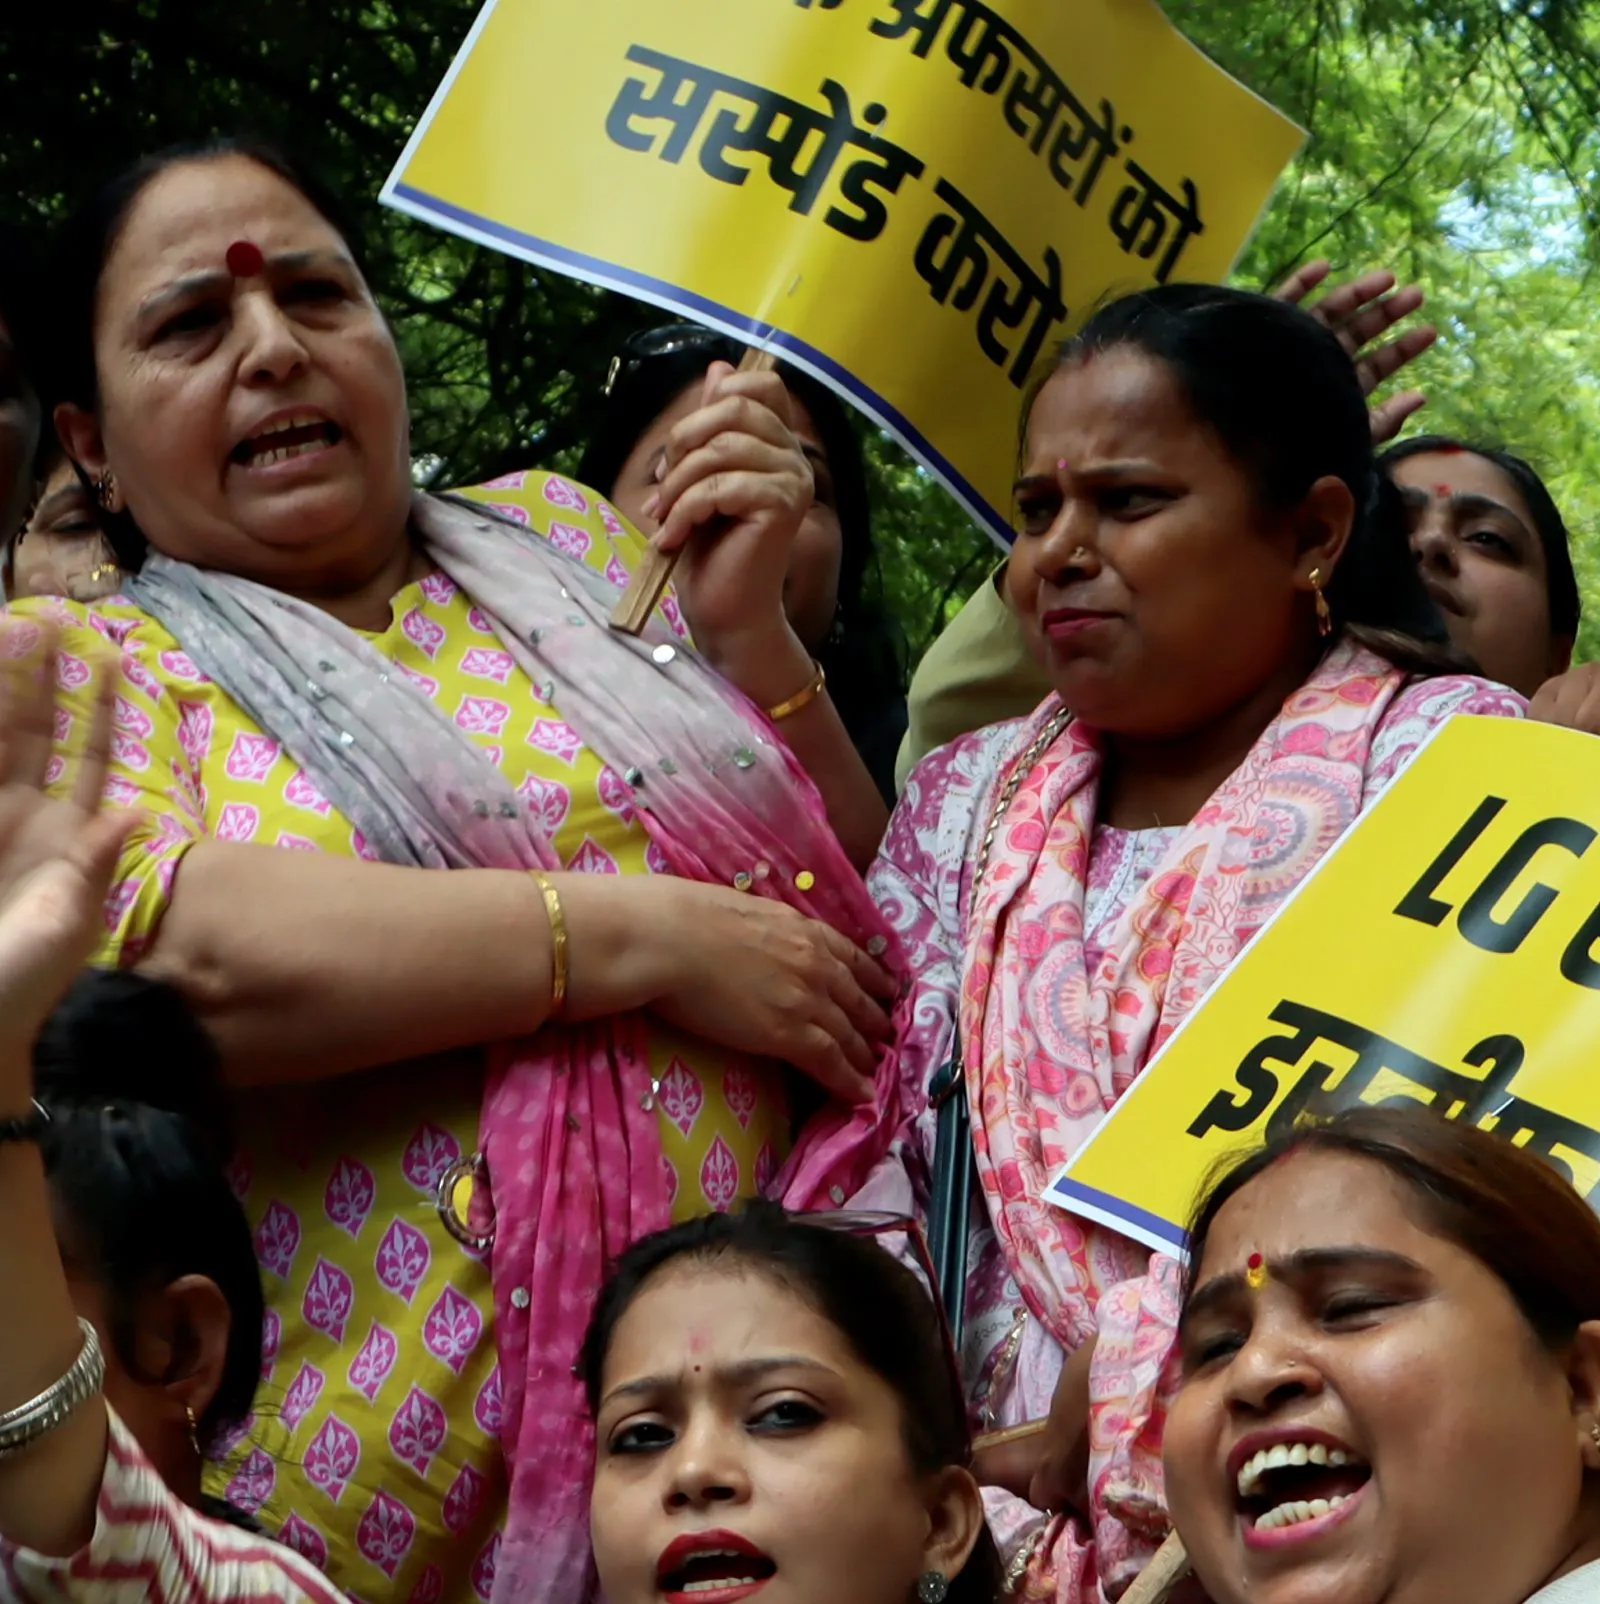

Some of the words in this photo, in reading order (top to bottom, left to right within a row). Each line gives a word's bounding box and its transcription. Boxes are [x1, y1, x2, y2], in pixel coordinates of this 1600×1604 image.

[605, 43, 926, 242] सस्पेंड
[913, 176, 1068, 389] करो
[1084, 158, 1204, 285] को
[1393, 796, 1598, 953] LG
